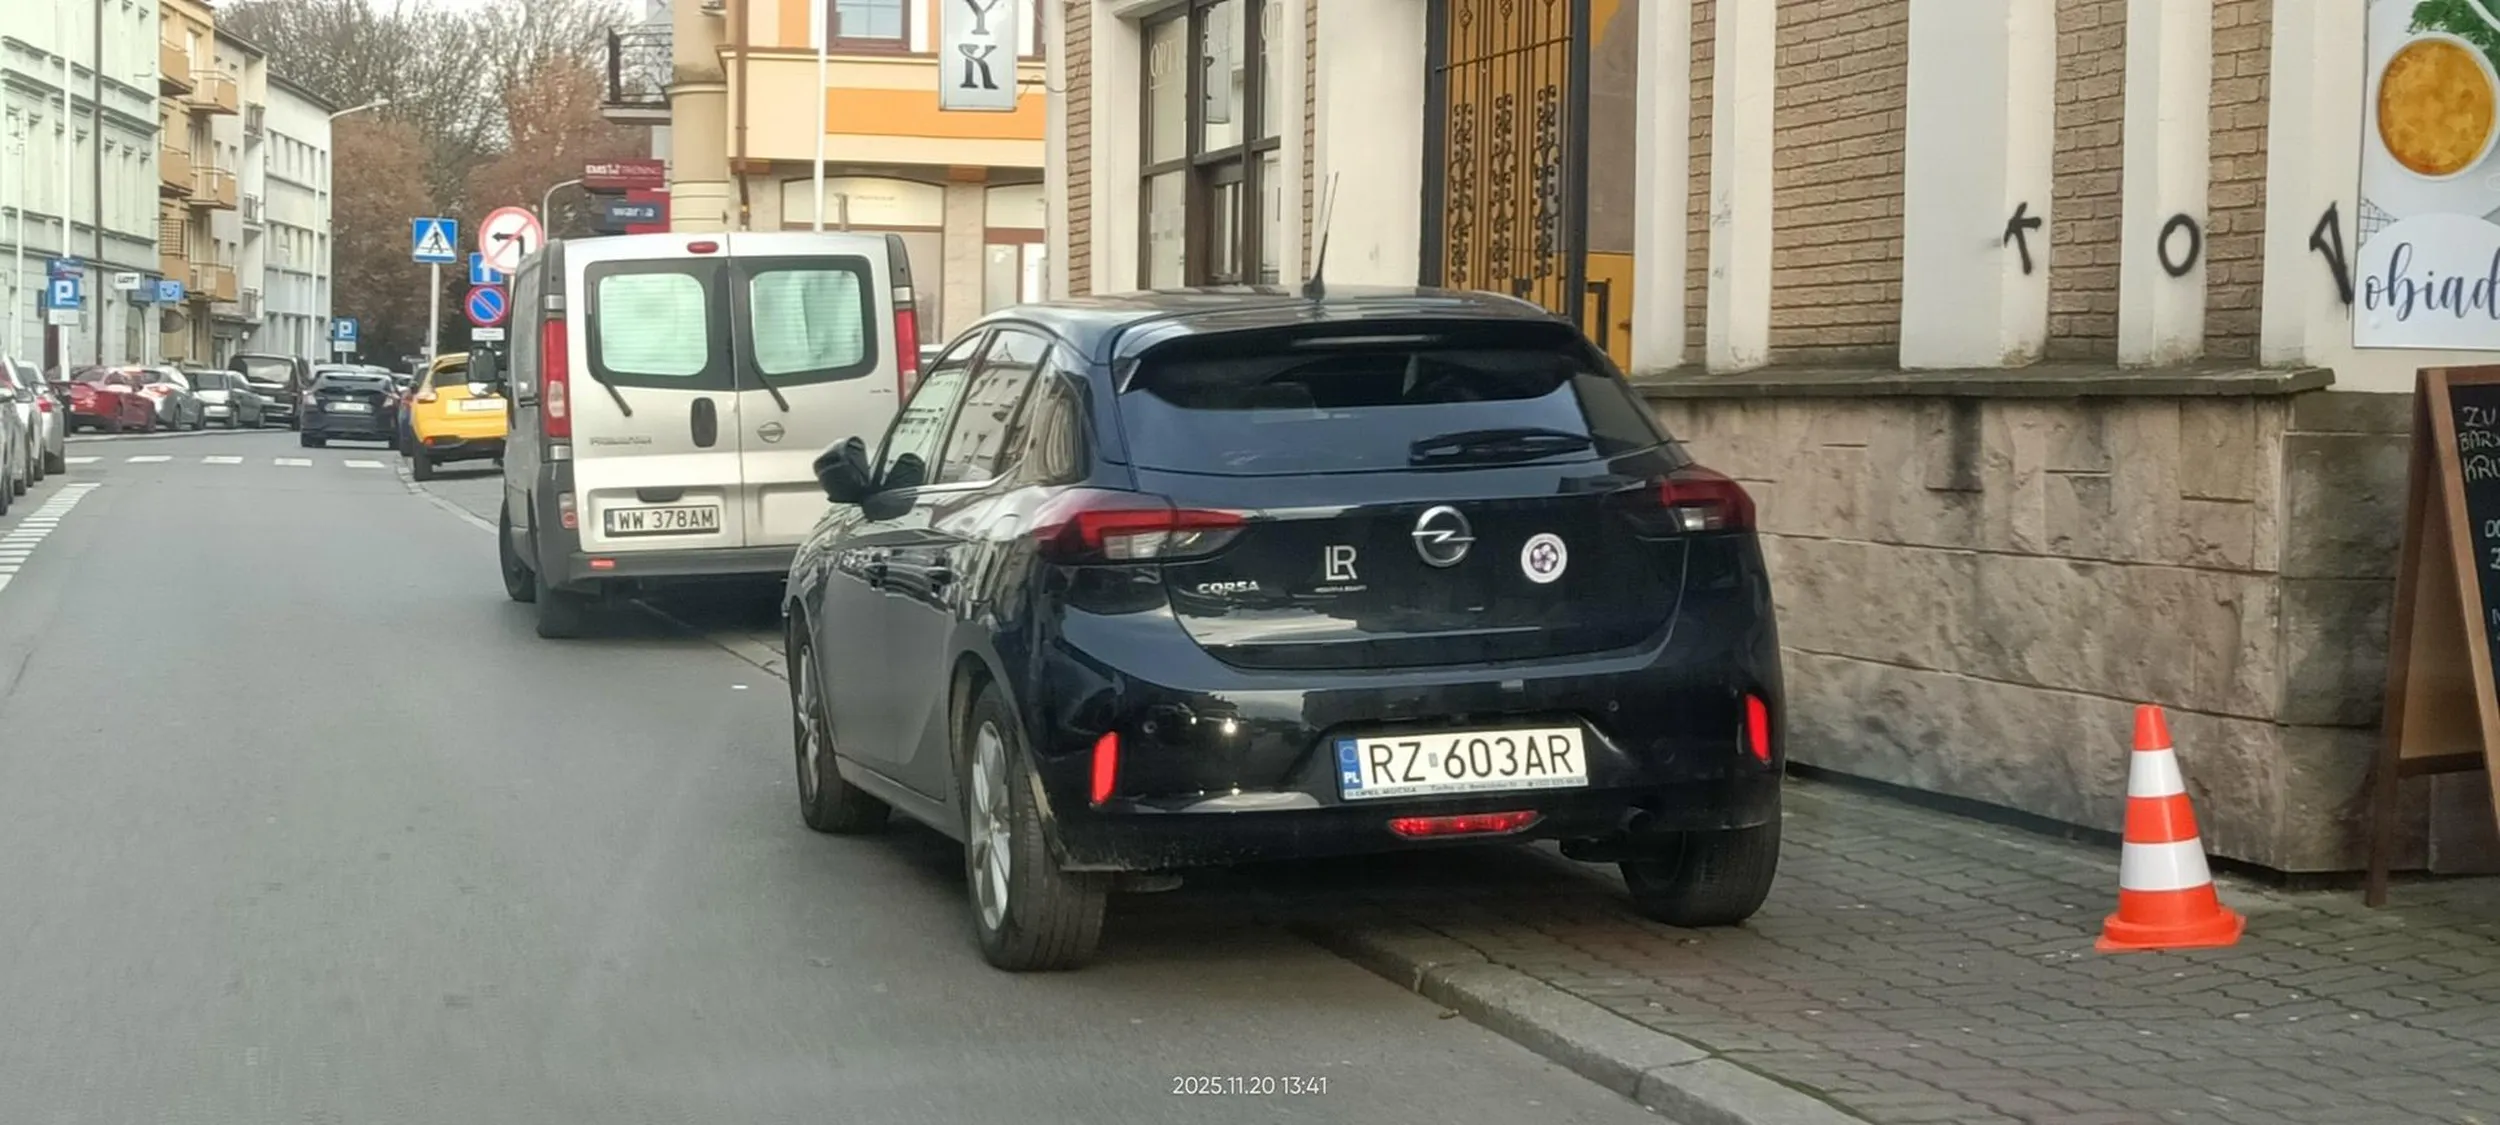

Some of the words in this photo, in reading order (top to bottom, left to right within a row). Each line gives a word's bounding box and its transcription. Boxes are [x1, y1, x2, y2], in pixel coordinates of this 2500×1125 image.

[619, 511, 645, 530] WW
[652, 508, 714, 528] 378AM
[1197, 580, 1261, 596] CORSA
[1368, 741, 1427, 785] RZ
[1443, 734, 1574, 780] 603AR
[1343, 771, 1360, 784] PL
